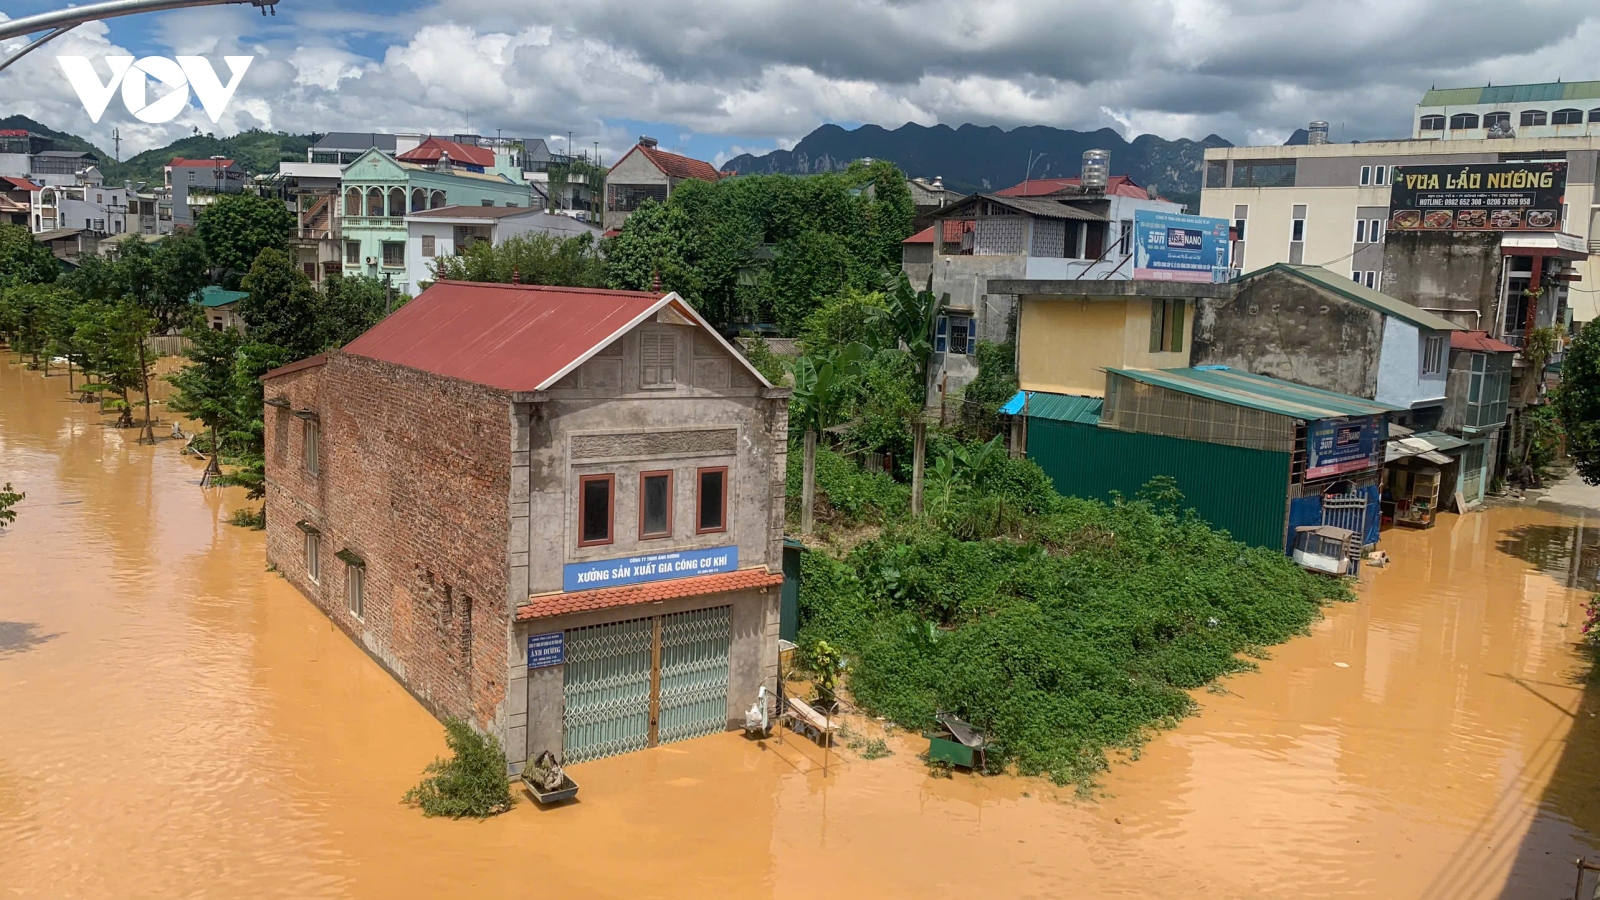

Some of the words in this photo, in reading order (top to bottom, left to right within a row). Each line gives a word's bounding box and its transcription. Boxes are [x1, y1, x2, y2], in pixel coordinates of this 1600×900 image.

[1406, 174, 1440, 190] VUA
[1446, 166, 1482, 190] LẨU
[1486, 168, 1553, 189] NƯỚNG
[1170, 234, 1184, 244] USA
[1185, 234, 1202, 246] NANO
[577, 567, 609, 583] XƯỞNG
[612, 564, 631, 579] SẢN
[633, 562, 656, 576] XUẤT
[658, 562, 673, 573] GIA
[675, 558, 698, 571] CÔNG
[700, 557, 712, 568] CƠ
[713, 554, 728, 567] KHÍ
